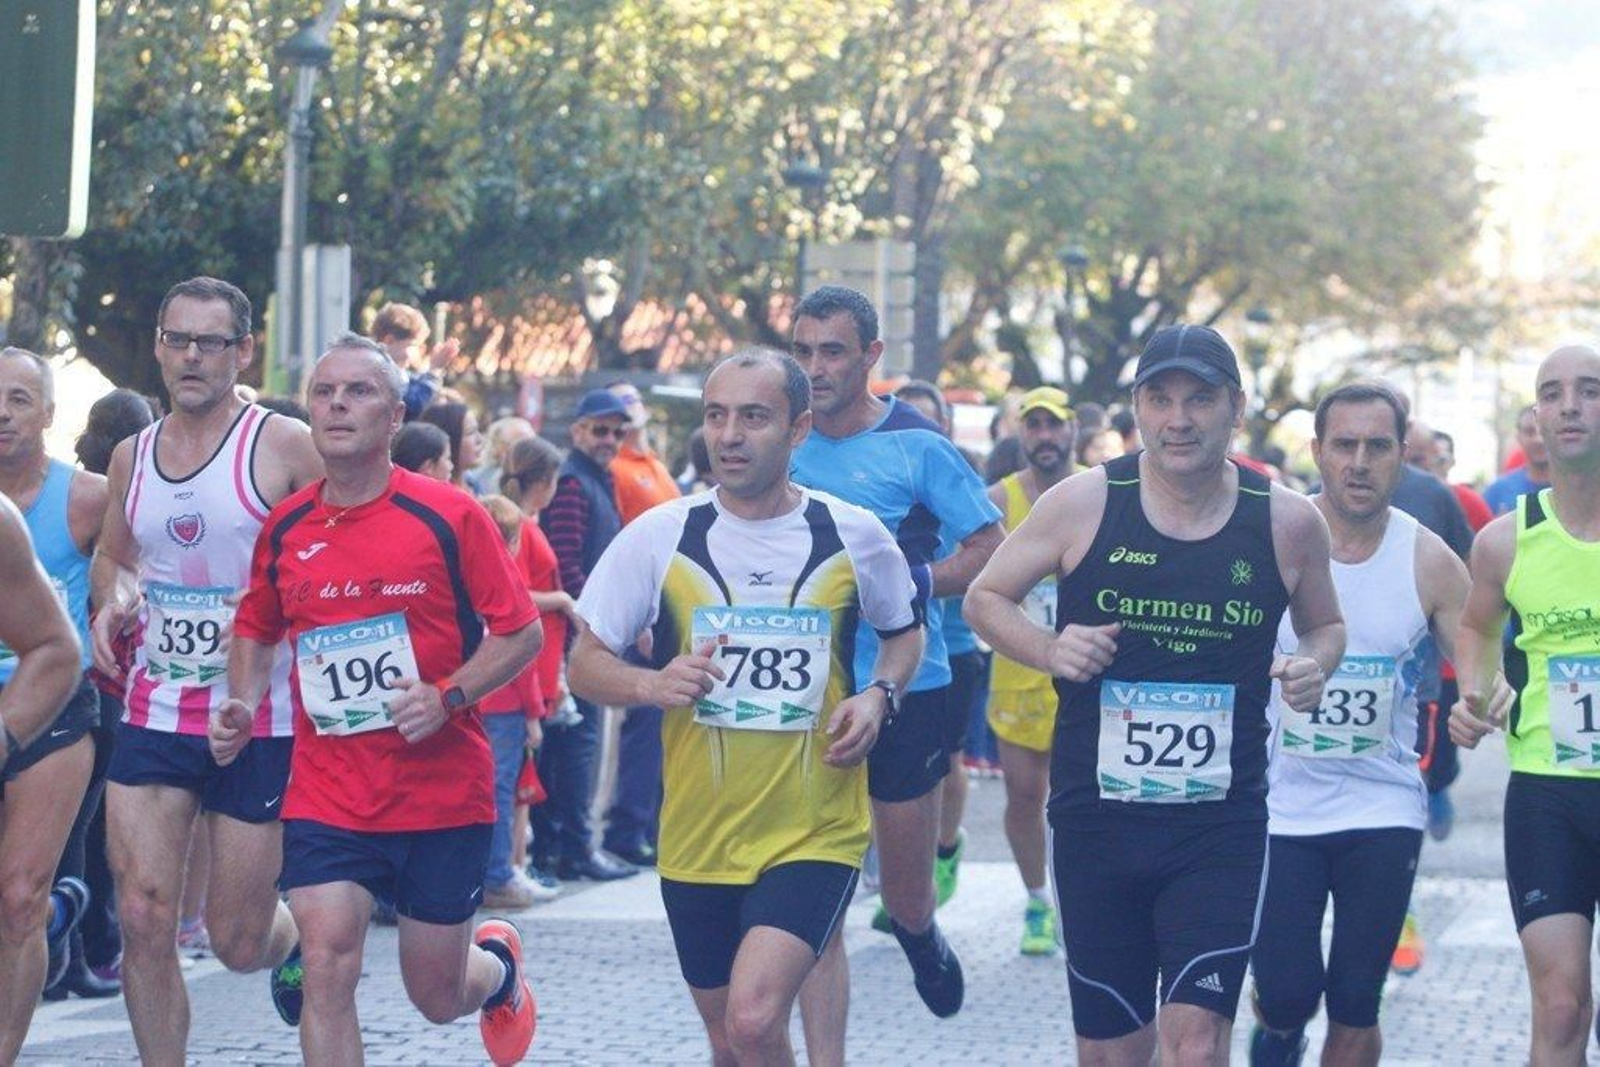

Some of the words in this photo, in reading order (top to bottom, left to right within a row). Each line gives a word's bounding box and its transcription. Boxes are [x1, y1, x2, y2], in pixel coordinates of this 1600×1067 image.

[1124, 551, 1157, 566] asics
[319, 580, 339, 599] de
[344, 579, 362, 598] la
[1096, 589, 1212, 622] Carmen
[1222, 600, 1264, 627] Sio
[158, 616, 221, 656] 539
[1152, 637, 1197, 653] Vigo
[322, 651, 403, 702] 196
[720, 646, 812, 691] 783
[1124, 722, 1216, 768] 529
